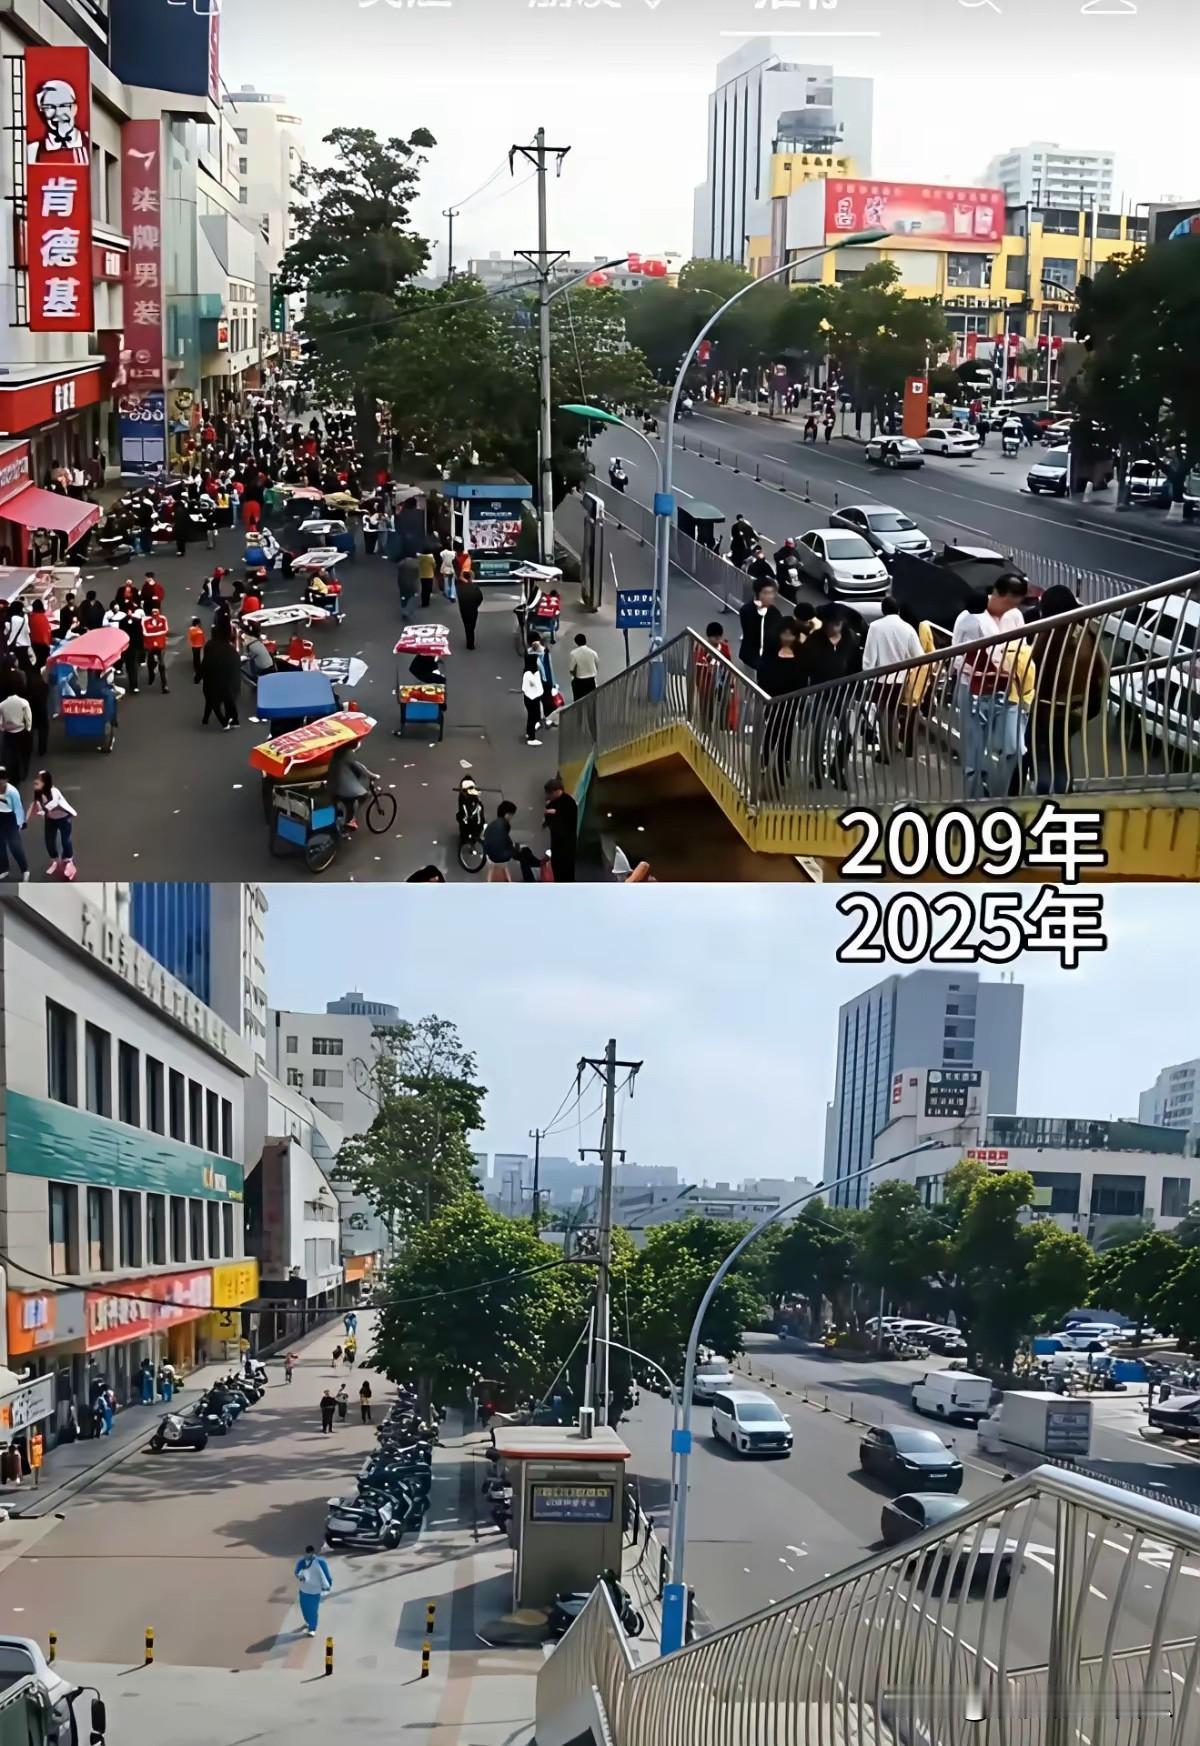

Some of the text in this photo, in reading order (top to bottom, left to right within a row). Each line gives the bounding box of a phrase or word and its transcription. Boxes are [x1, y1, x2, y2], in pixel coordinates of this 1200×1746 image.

[40, 176, 82, 318] 肯德基
[131, 186, 161, 325] 柒牌男装
